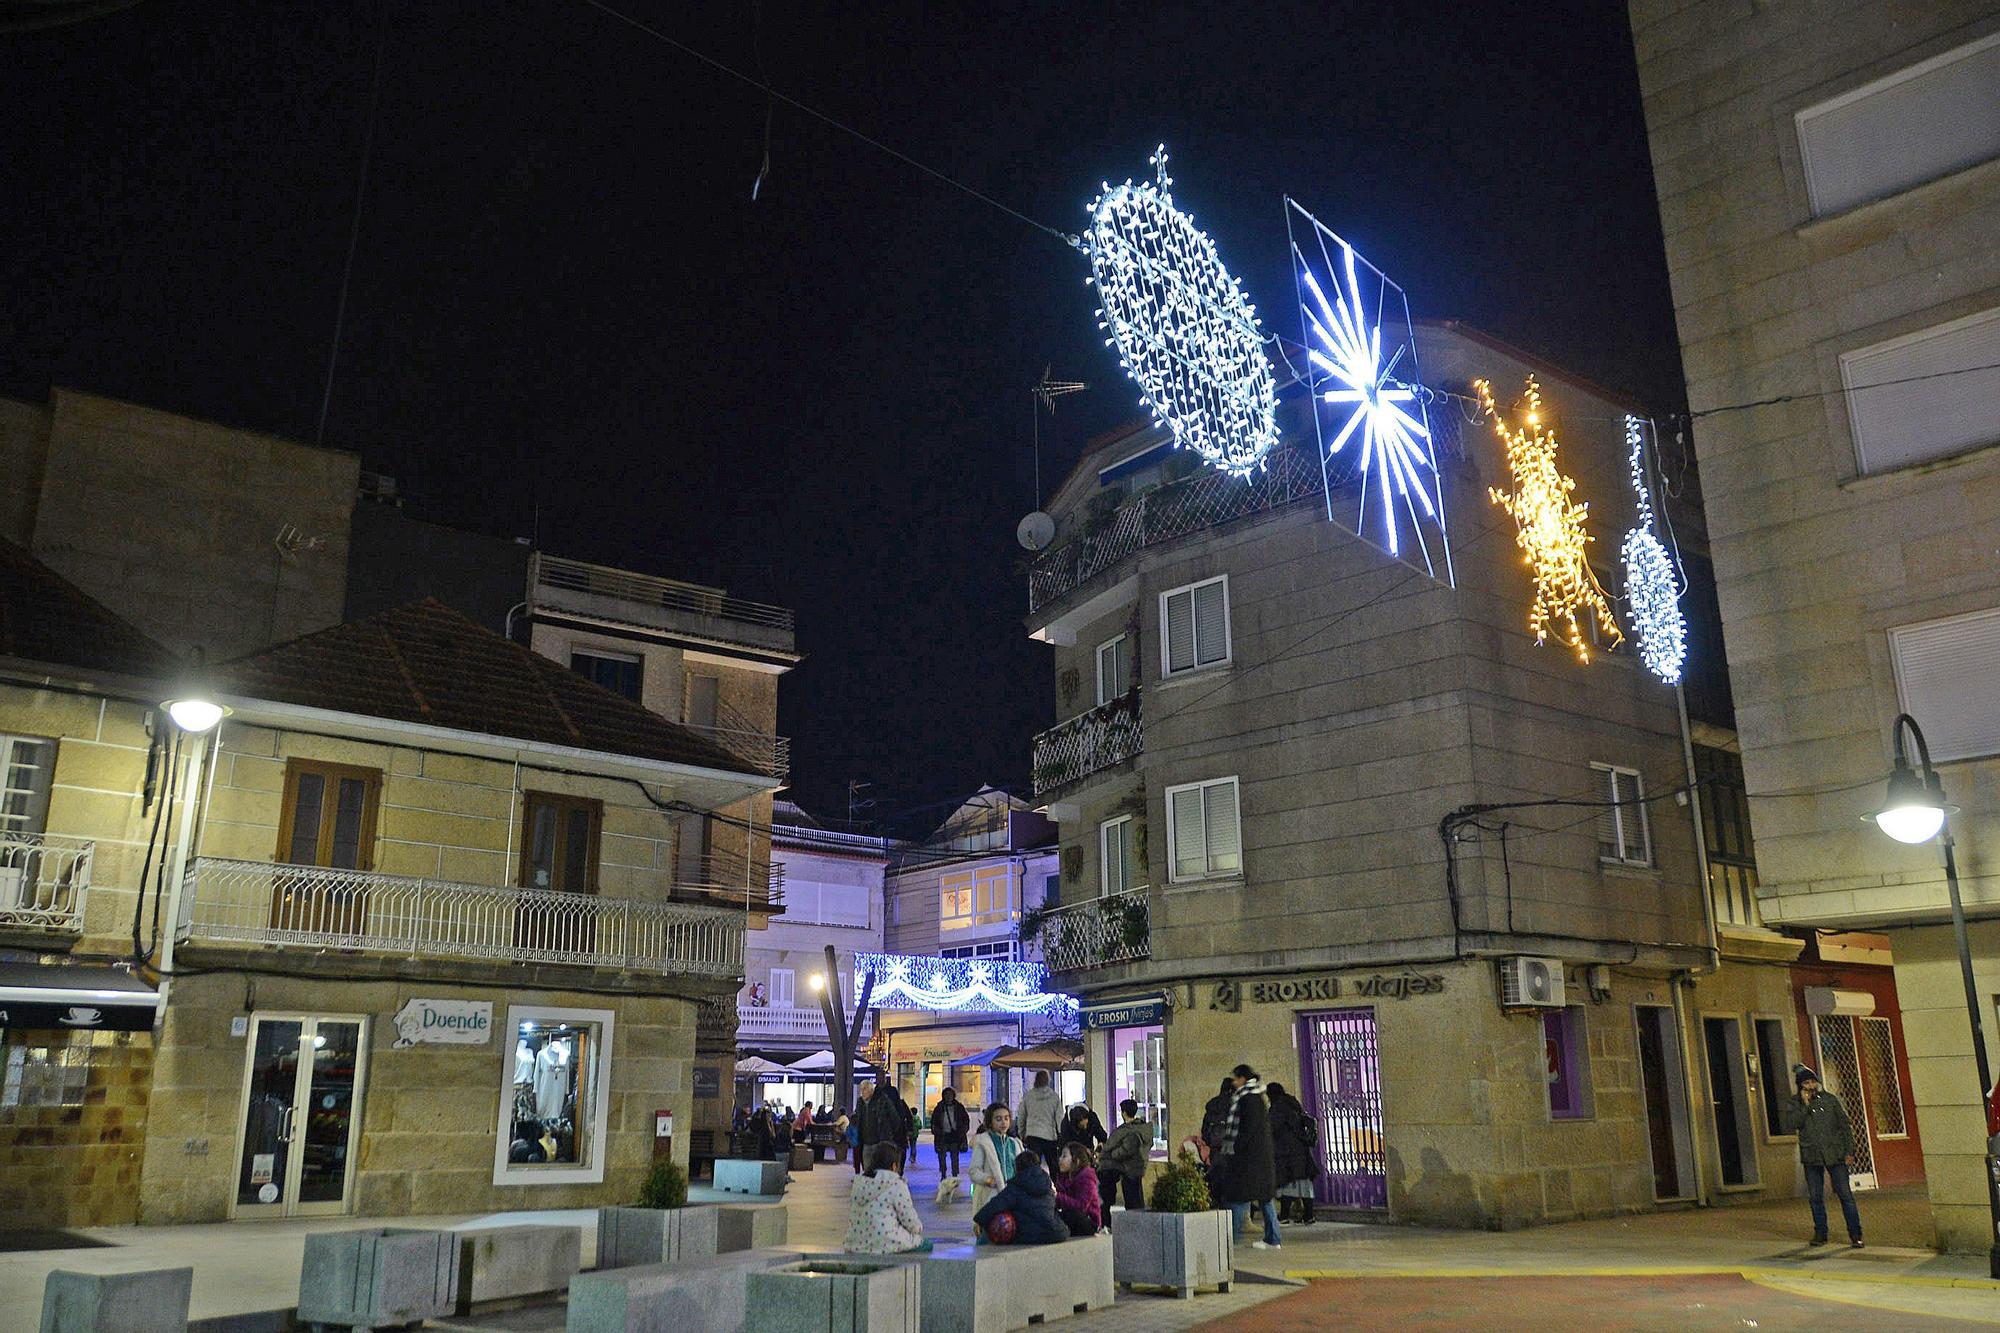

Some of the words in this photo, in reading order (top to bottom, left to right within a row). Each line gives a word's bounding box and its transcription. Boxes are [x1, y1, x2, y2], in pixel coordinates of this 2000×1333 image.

[1251, 978, 1340, 1001] EROSKI
[1354, 973, 1443, 1000] viajes
[423, 1008, 487, 1029] Duende
[1098, 1010, 1129, 1024] EROSKI
